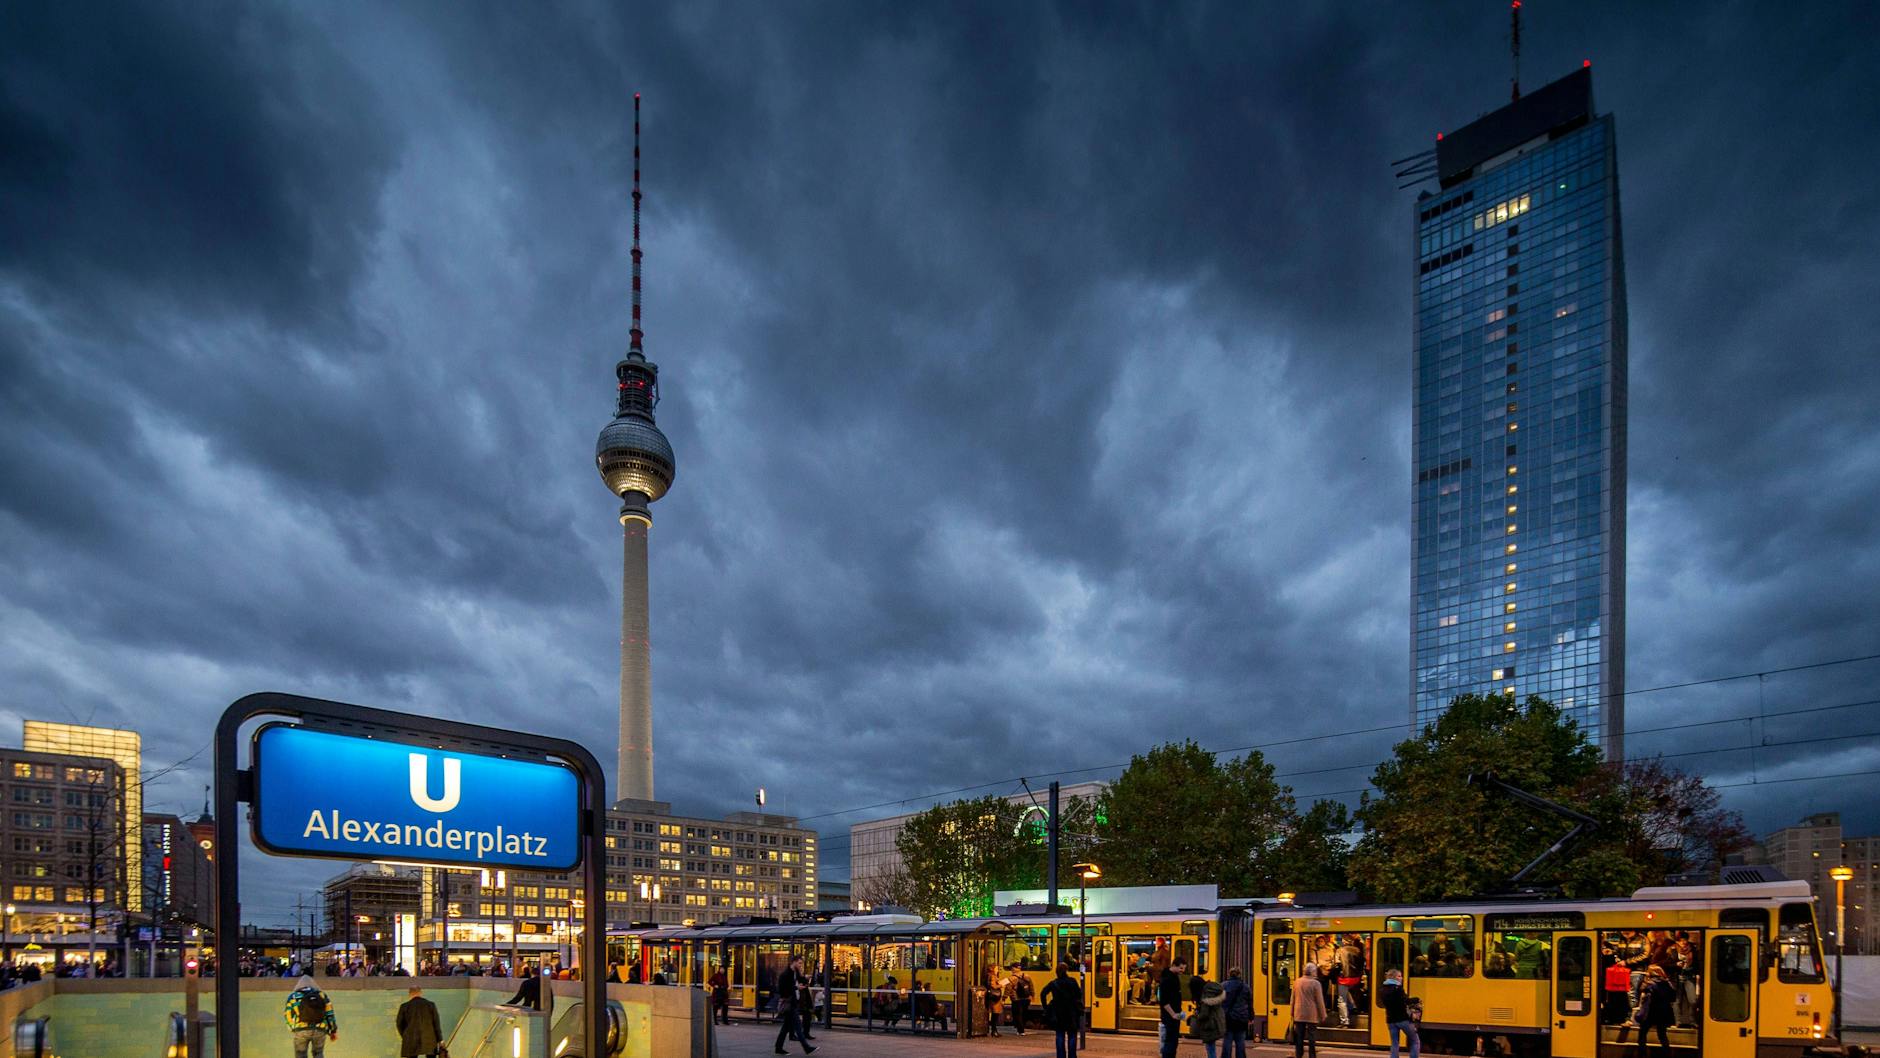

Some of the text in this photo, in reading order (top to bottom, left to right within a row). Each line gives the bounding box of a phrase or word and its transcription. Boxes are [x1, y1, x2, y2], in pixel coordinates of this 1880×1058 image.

[409, 753, 461, 813] U
[303, 809, 548, 858] Alexanderplatz
[1787, 1027, 1809, 1035] 7057
